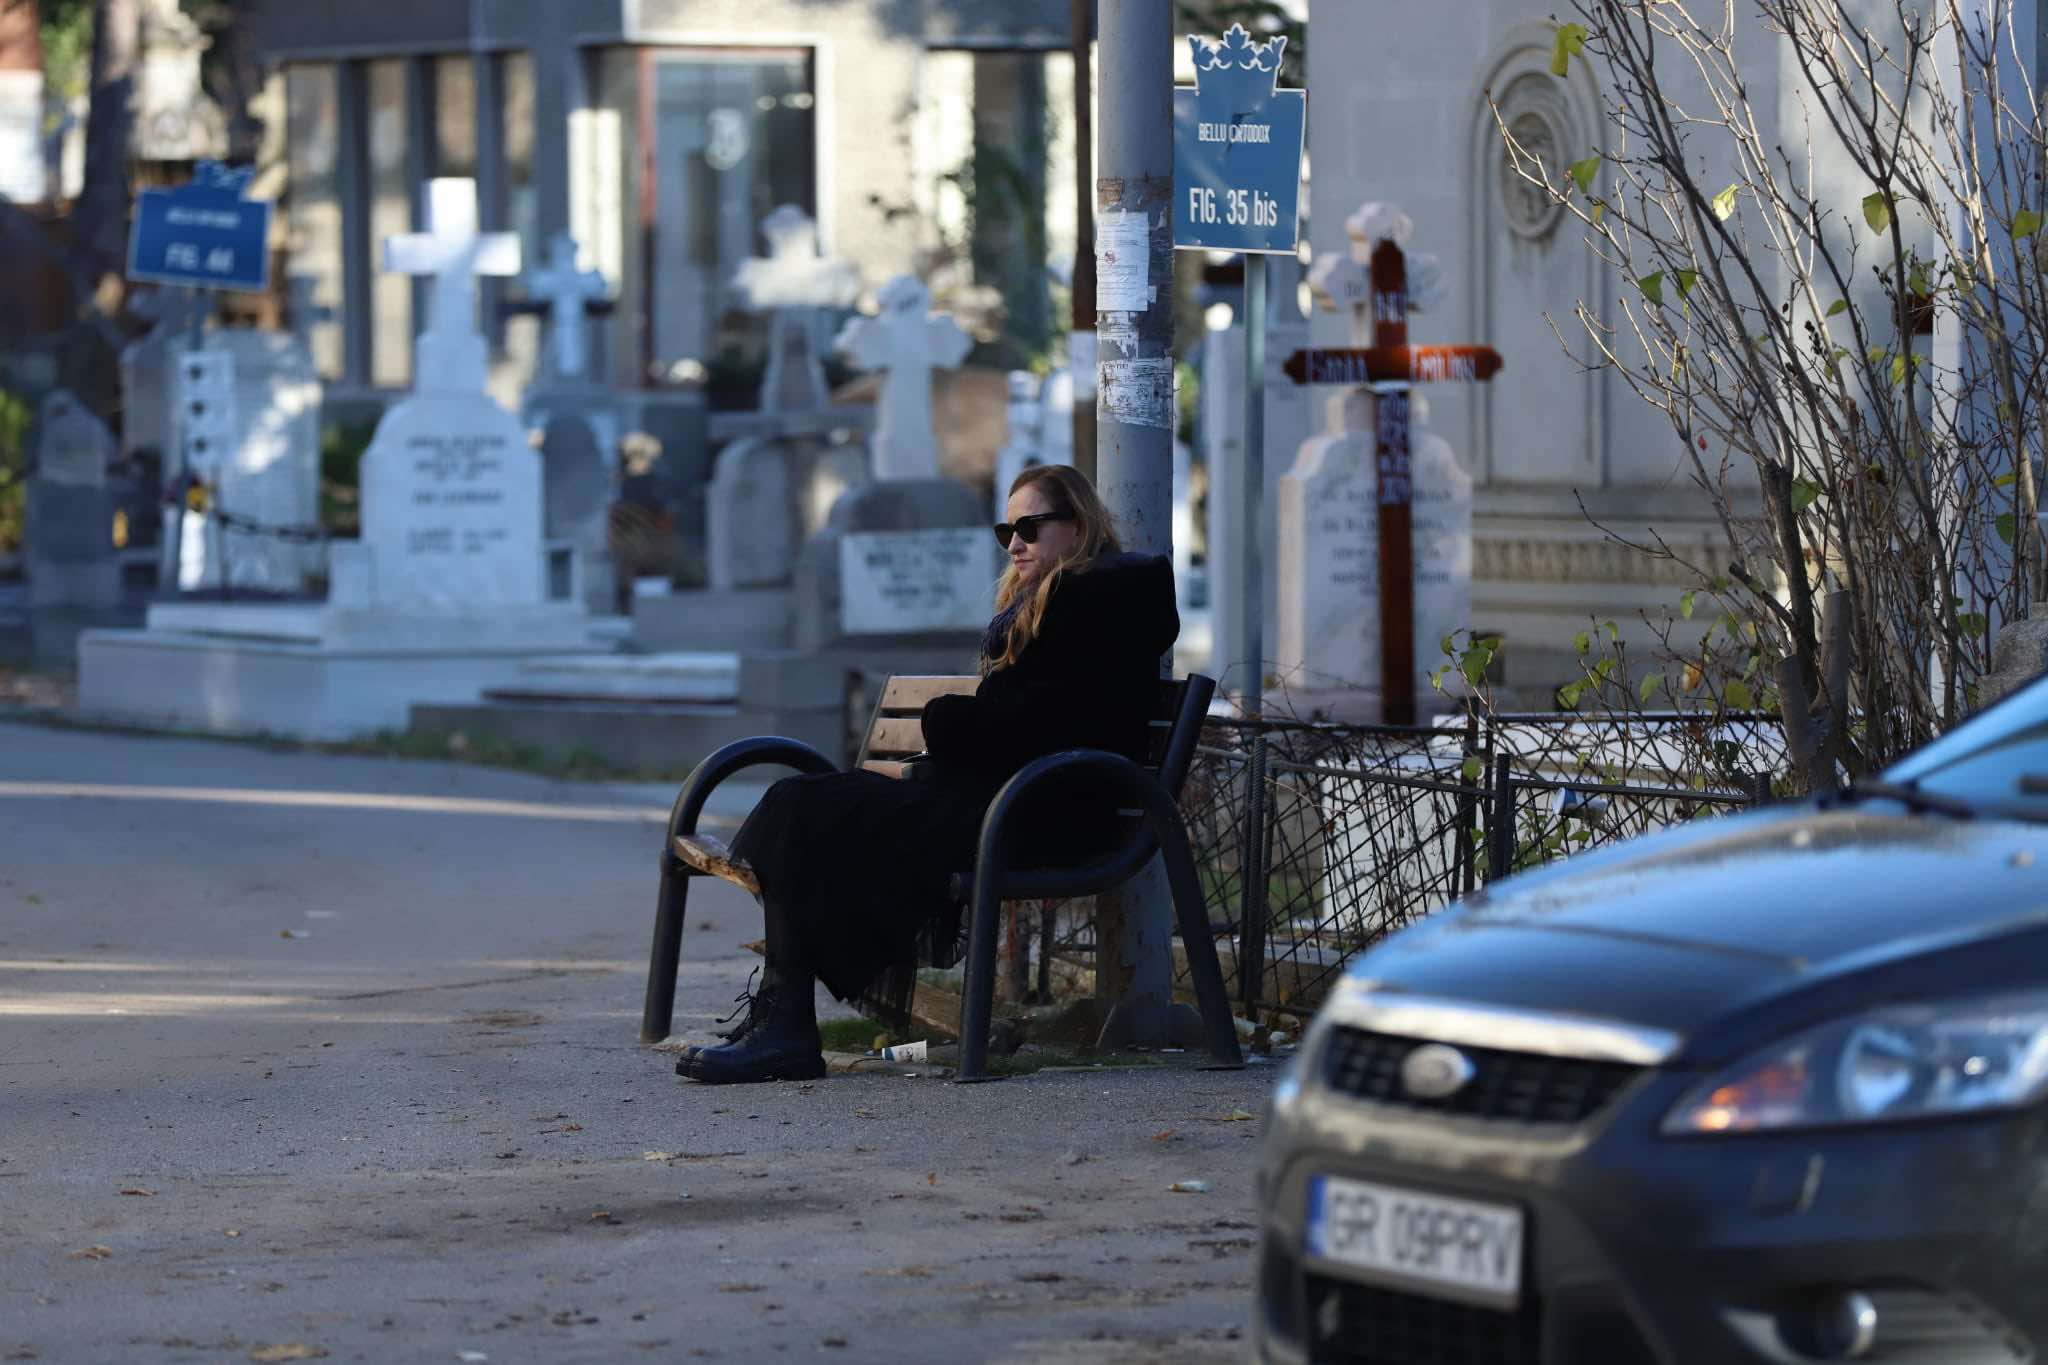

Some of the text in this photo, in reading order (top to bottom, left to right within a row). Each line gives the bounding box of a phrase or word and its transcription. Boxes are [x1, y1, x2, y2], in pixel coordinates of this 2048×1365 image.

[1198, 122, 1227, 142] BELLU
[1189, 186, 1278, 227] FIG. 35 bis
